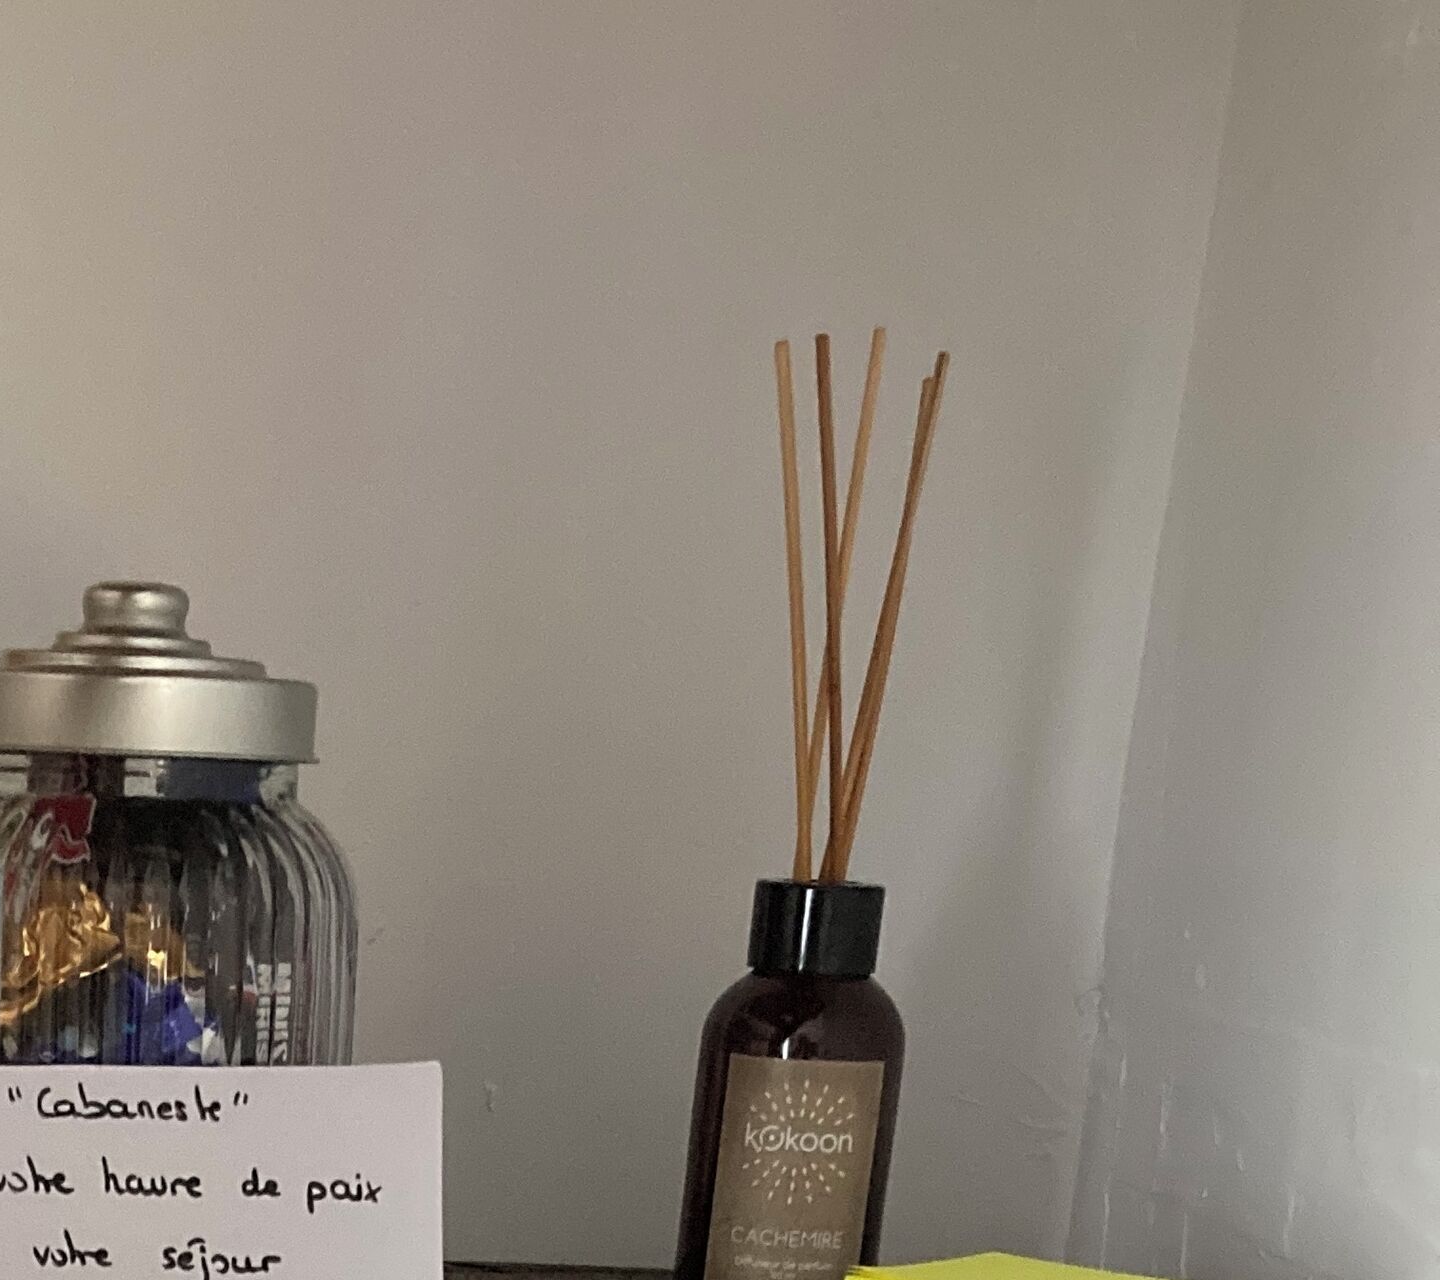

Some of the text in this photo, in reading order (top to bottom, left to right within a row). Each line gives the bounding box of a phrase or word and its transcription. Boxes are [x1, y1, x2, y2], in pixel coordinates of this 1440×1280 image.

[101, 1155, 203, 1198] havre
[240, 1167, 282, 1197] de
[306, 1173, 382, 1215] paix
[33, 1228, 113, 1268] votre
[730, 1225, 844, 1249] CACHEMIRE
